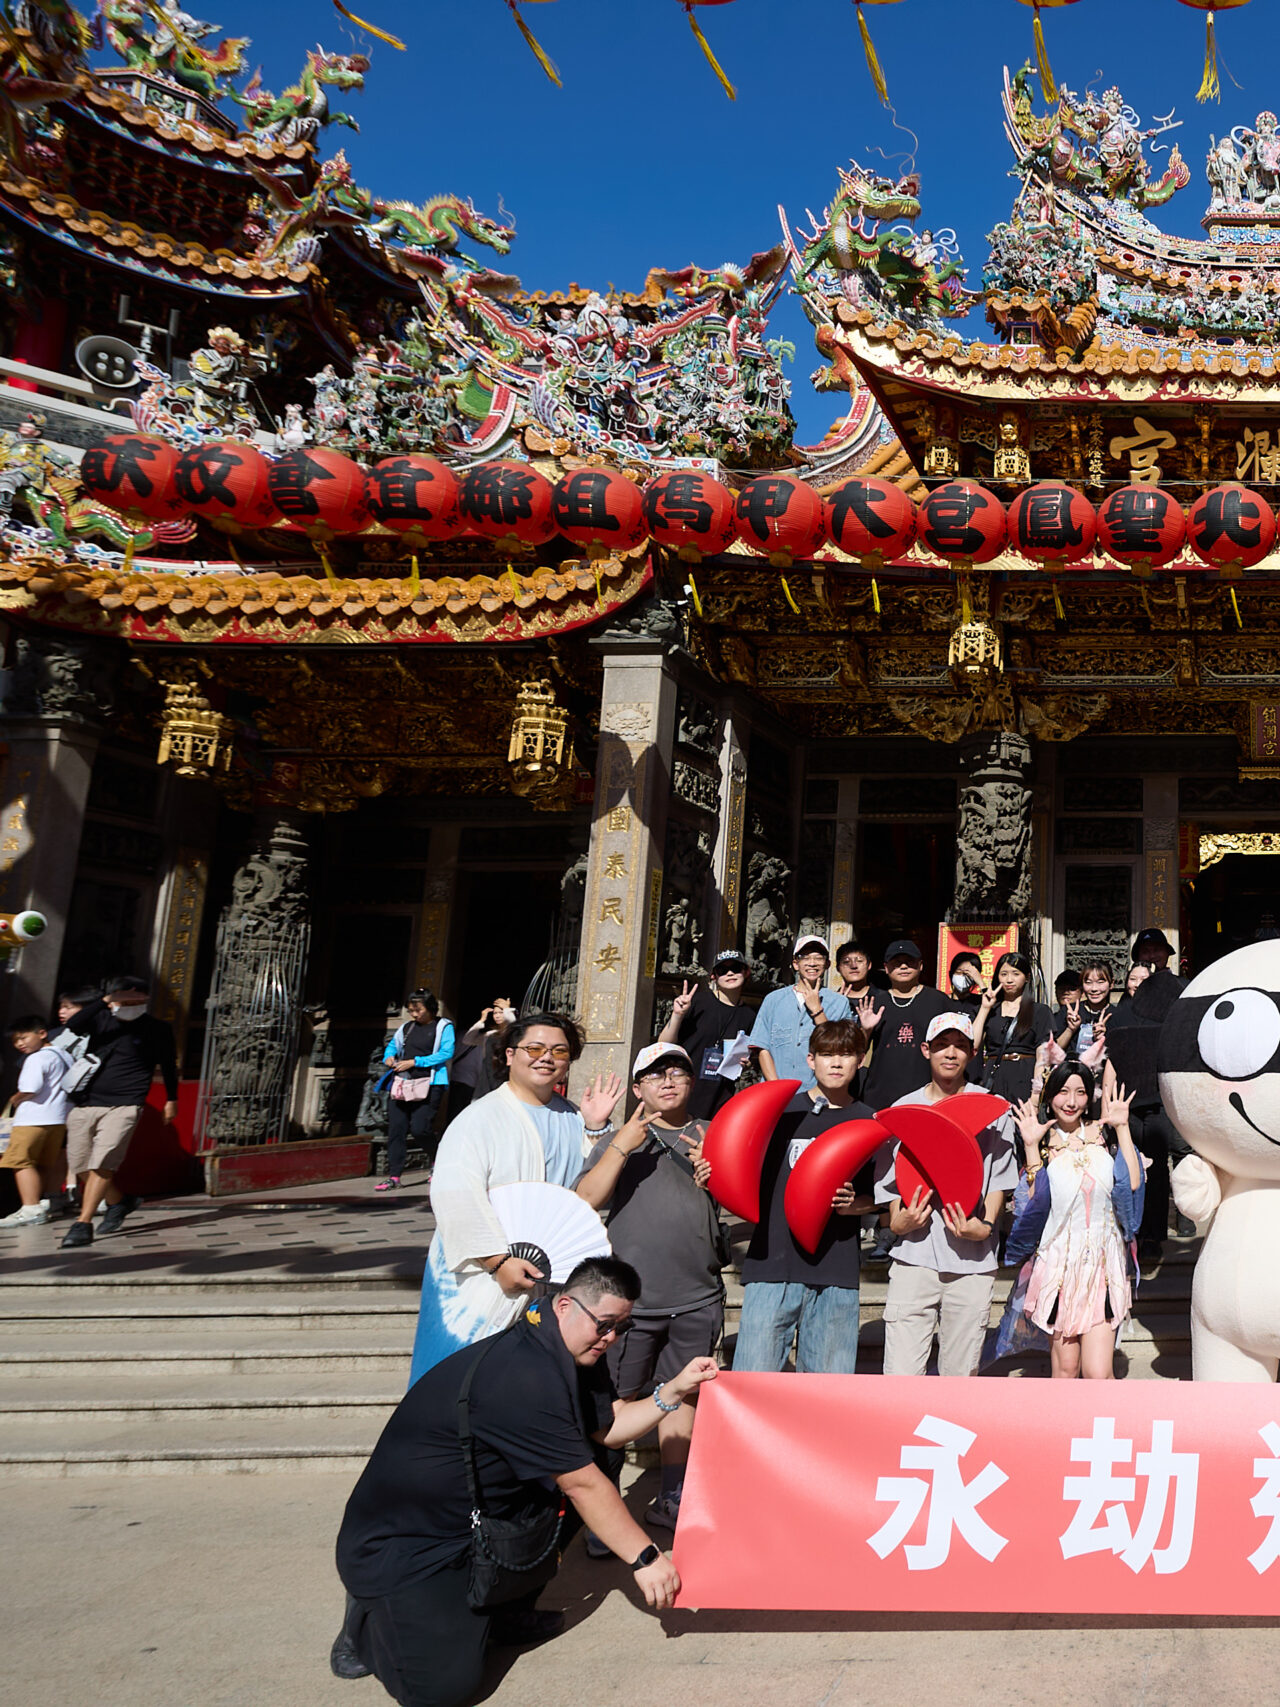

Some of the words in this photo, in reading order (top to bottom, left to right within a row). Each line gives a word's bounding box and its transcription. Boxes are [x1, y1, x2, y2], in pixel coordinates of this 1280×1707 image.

[1262, 706, 1278, 756] 鎮瀾宮
[592, 805, 632, 973] 國泰民安
[967, 934, 1006, 947] 歡迎
